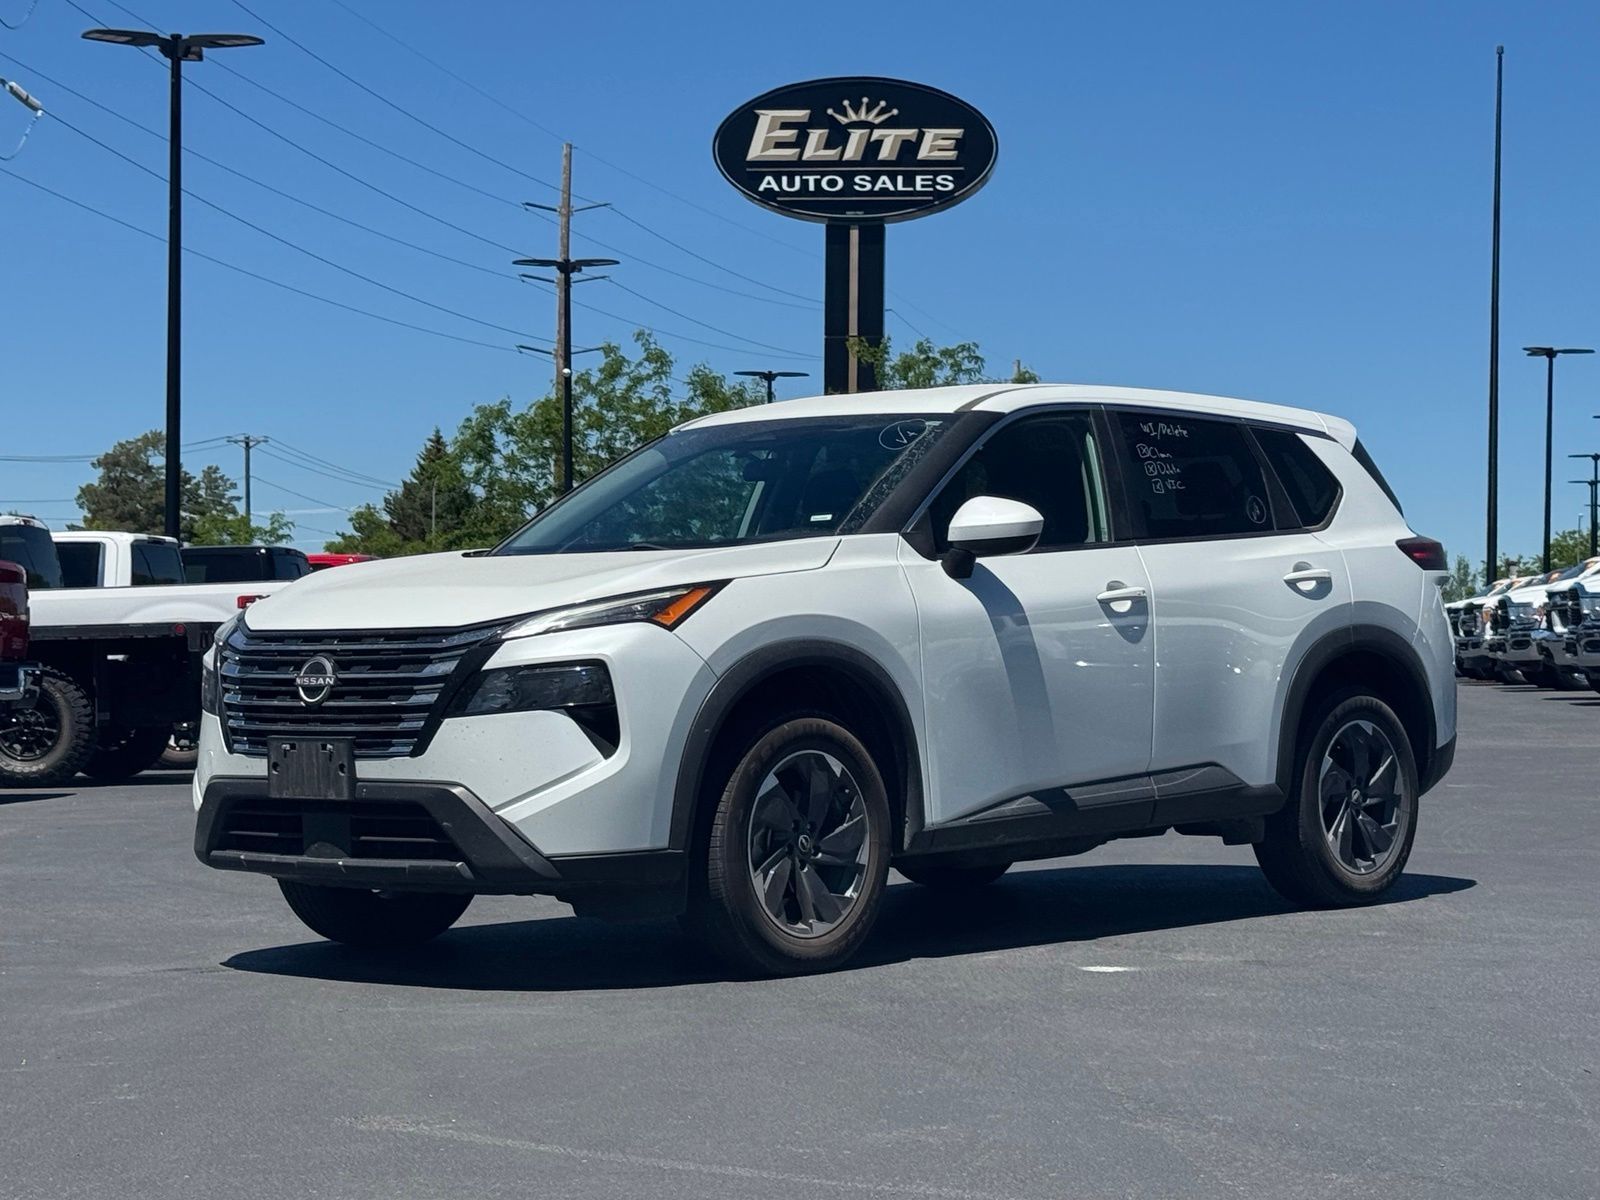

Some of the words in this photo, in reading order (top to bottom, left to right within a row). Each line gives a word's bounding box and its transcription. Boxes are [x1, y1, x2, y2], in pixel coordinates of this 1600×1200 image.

[745, 109, 965, 161] ELITE
[758, 174, 844, 191] AUTO
[853, 174, 955, 191] SALES
[295, 676, 335, 686] NISSAN
